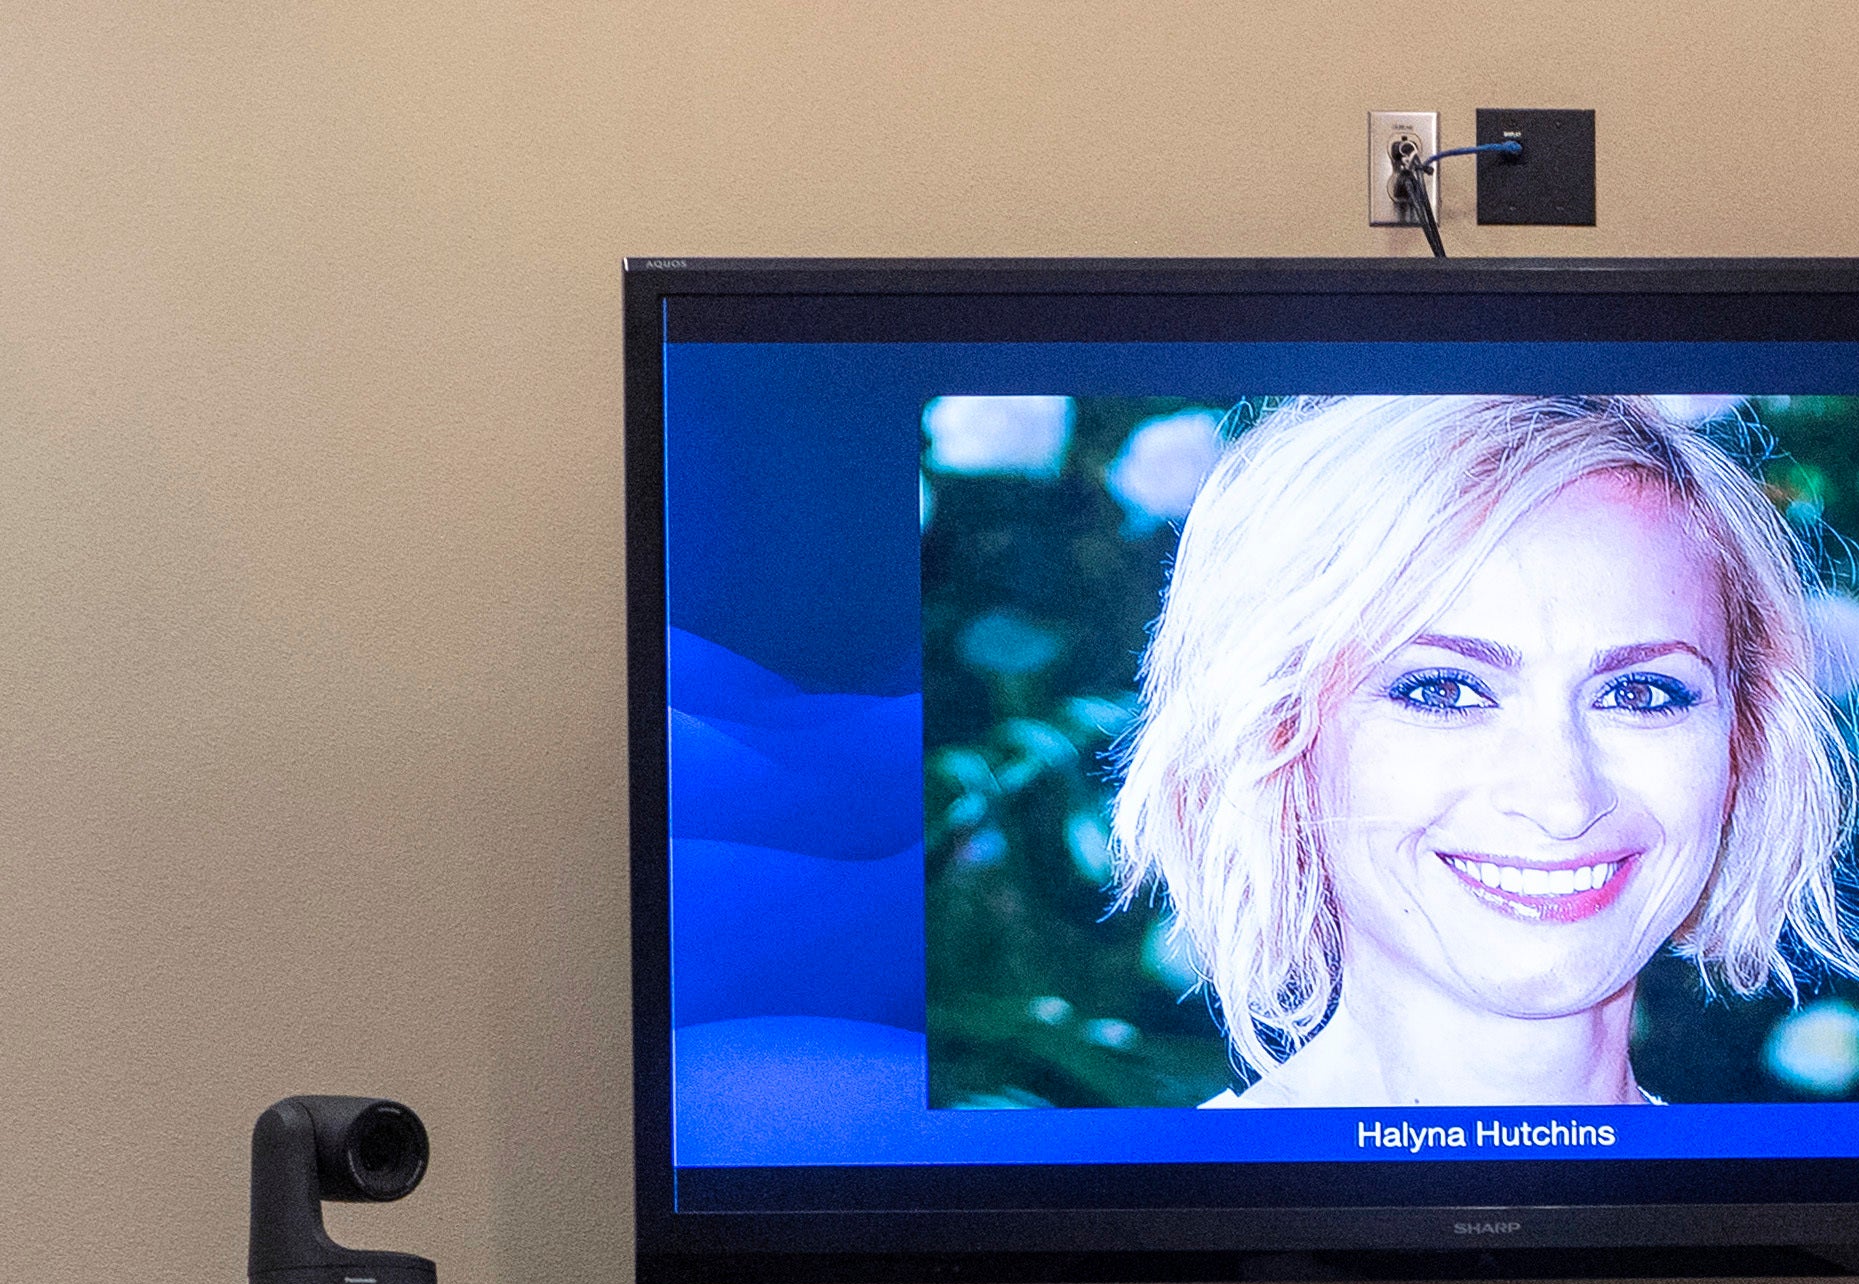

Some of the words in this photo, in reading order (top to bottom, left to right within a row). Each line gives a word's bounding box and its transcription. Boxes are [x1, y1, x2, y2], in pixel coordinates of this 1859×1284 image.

[1357, 1121, 1467, 1154] Halyna
[1476, 1120, 1616, 1147] Hutchins
[1453, 1222, 1521, 1235] SHARP
